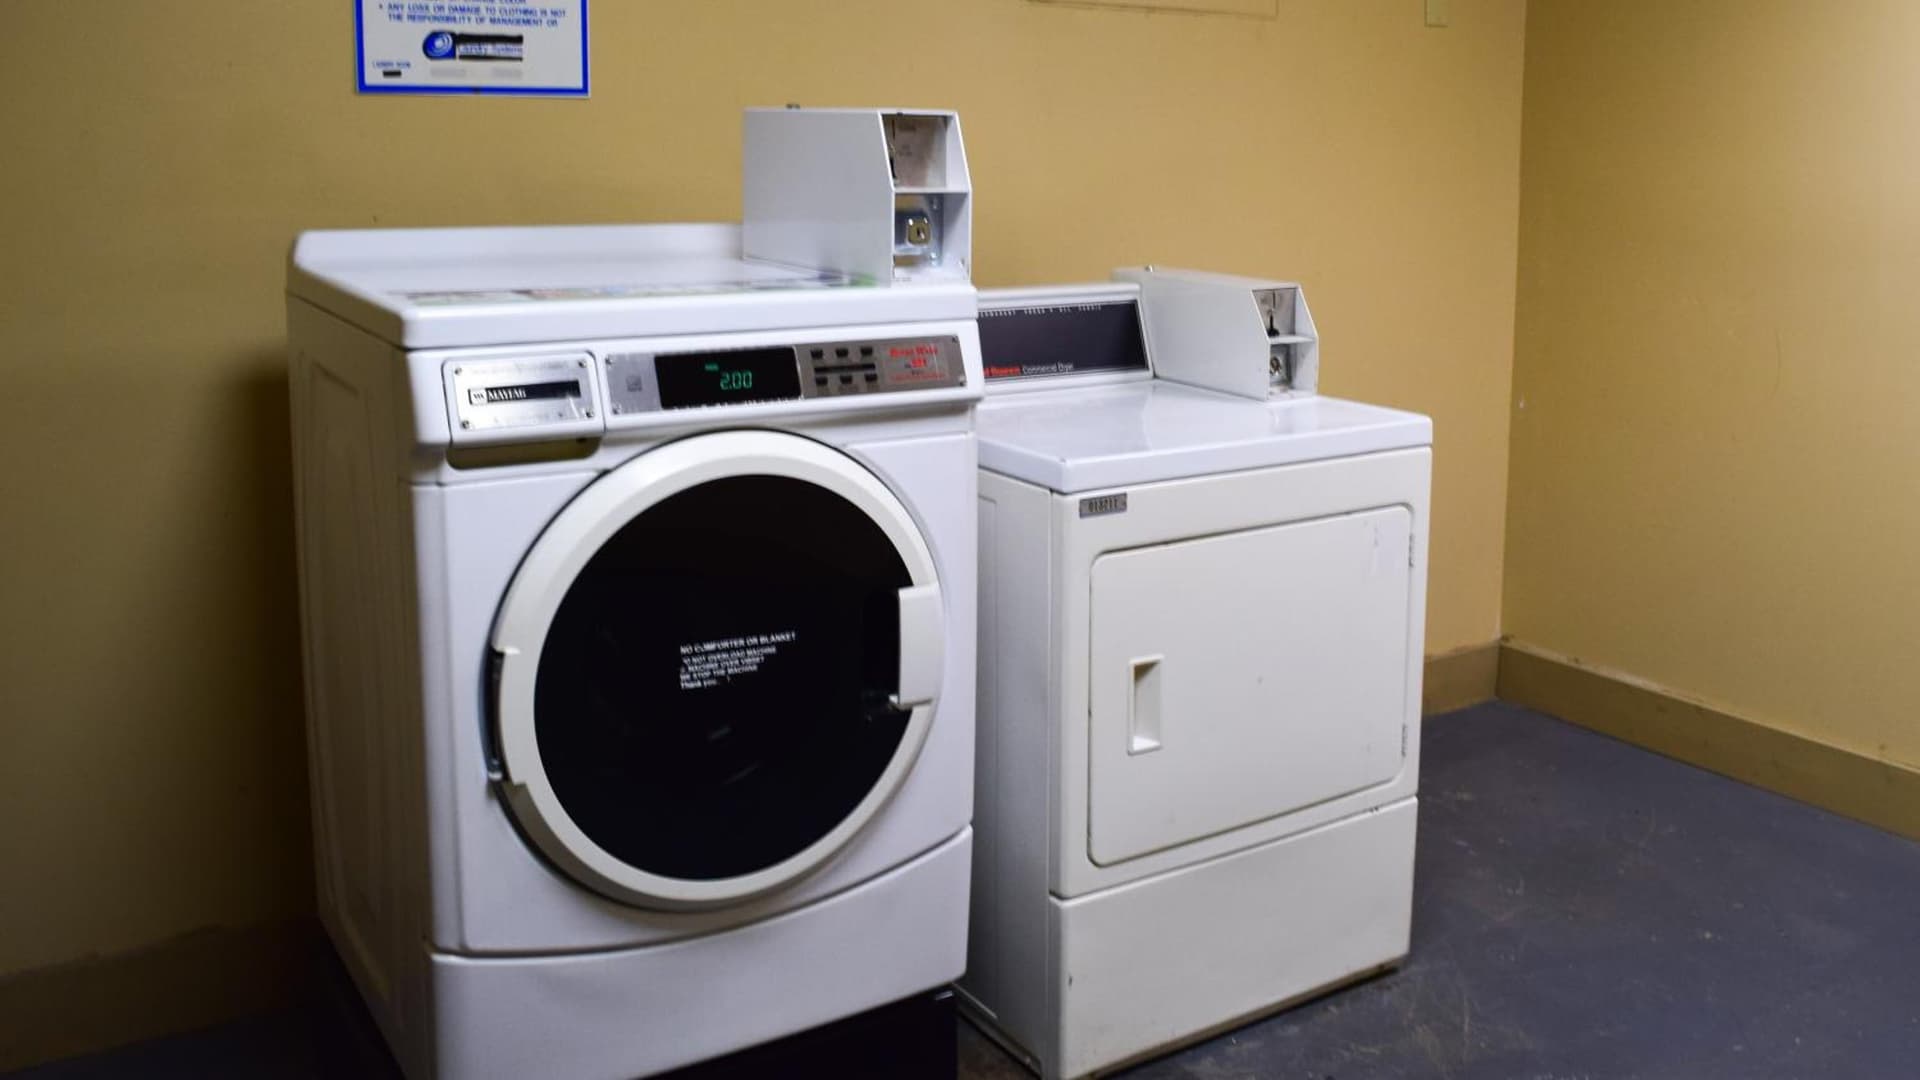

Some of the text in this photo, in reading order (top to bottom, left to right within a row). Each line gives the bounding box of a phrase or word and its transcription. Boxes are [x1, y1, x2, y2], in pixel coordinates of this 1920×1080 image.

[387, 3, 404, 12] ANY
[433, 4, 445, 13] OR
[447, 4, 480, 14] DAMAGE
[485, 6, 497, 15] TO
[499, 7, 538, 16] CLOTHING
[540, 8, 548, 17] IS
[550, 8, 566, 18] NOT
[387, 13, 558, 27] THE RESPONSIBILITY OF MANAGEMENT OR
[720, 370, 753, 390] 2.00
[487, 387, 527, 401] MAYTAG
[679, 631, 797, 654] NO COMFORTER OR BLANKET
[692, 655, 706, 664] NOT
[707, 649, 746, 661] OVERLOAD
[746, 646, 776, 656] MACHINE
[727, 665, 758, 675] MACHINE
[680, 681, 702, 689] Thank
